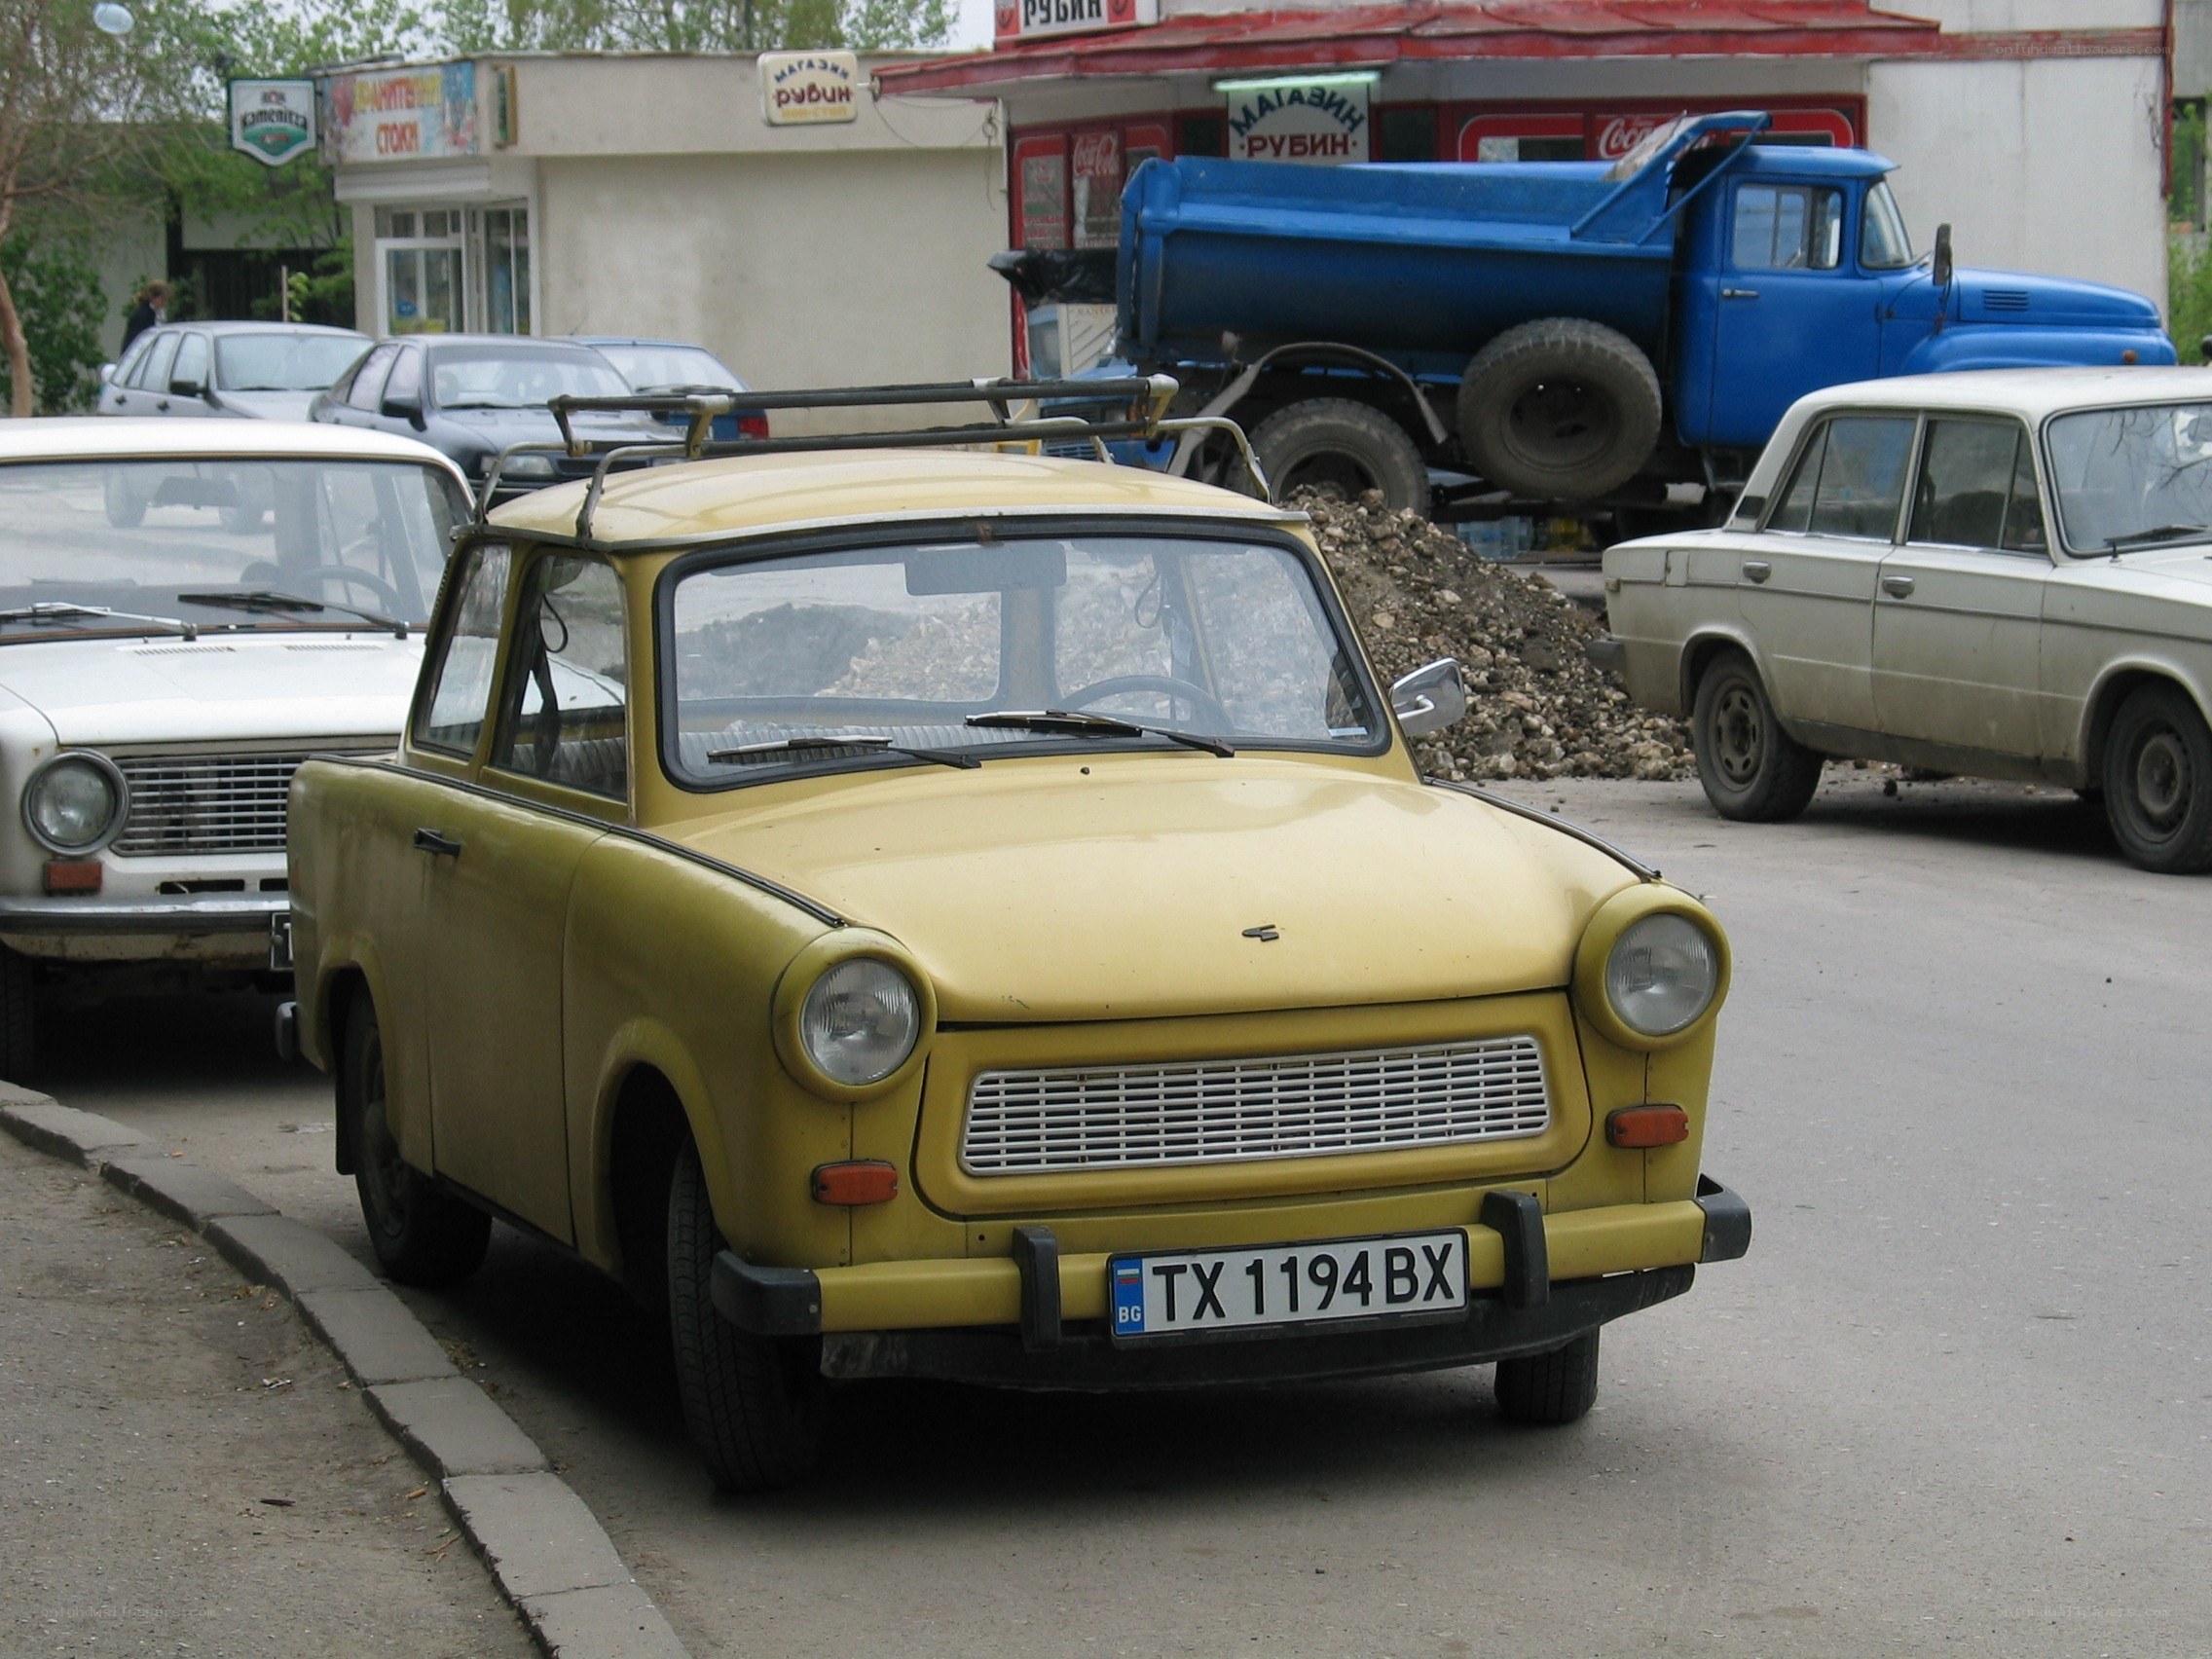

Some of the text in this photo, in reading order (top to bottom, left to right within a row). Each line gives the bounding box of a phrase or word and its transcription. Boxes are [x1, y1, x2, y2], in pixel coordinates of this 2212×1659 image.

[774, 59, 849, 83] МАГАЗИН
[1230, 87, 1365, 136] МАГАЗИН
[377, 121, 419, 154] СТОКИ
[1246, 132, 1349, 158] РУБИН
[1152, 1260, 1226, 1322] TX
[1118, 1305, 1142, 1324] BG
